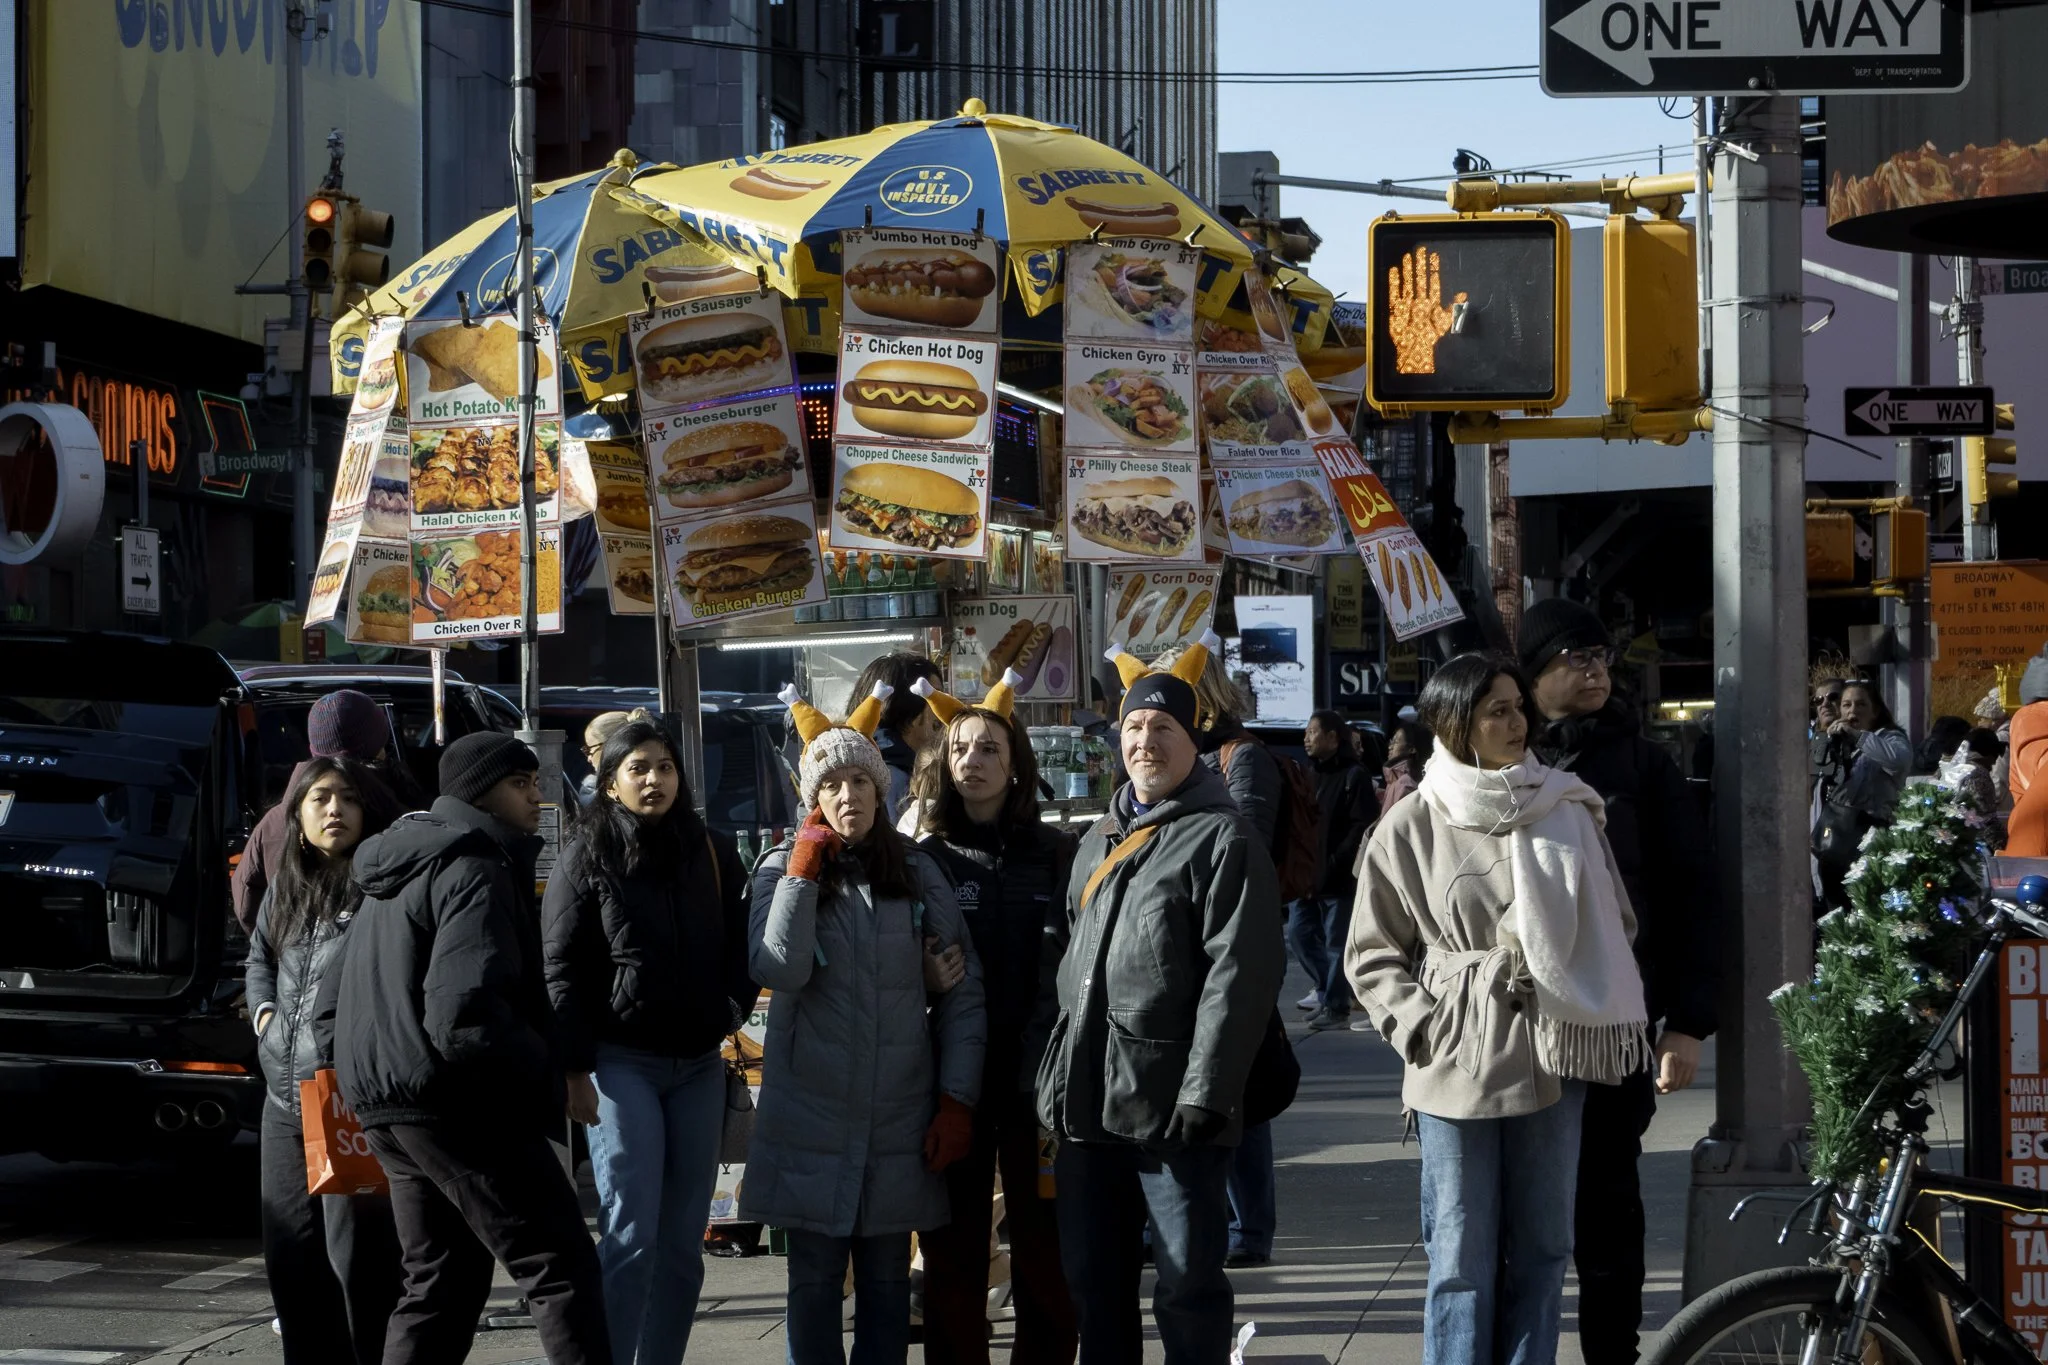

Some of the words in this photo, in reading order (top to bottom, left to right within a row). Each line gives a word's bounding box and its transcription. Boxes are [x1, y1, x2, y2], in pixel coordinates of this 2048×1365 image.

[1600, 0, 1721, 52] ONE
[1794, 0, 1924, 49] WAY
[1855, 68, 1871, 76] DEPT
[1875, 68, 1883, 76] OF
[1887, 67, 1942, 76] TRANSPORTATION
[1013, 168, 1147, 205] SABRETT
[886, 191, 959, 205] INSPECTED
[871, 230, 917, 243] Jumbo
[922, 233, 947, 245] Hot
[951, 235, 978, 250] Dog
[1109, 238, 1136, 249] amb
[1140, 240, 1171, 251] Gyro
[662, 304, 688, 320] Hot
[691, 294, 752, 315] Sausage
[845, 343, 863, 353] NY
[868, 338, 923, 357] Chicken
[927, 342, 953, 359] Hot
[956, 344, 984, 364] Dog
[1082, 346, 1133, 361] Chicken
[1137, 350, 1166, 365] Gyro
[1205, 354, 1236, 365] Chicken
[1238, 355, 1258, 365] Over
[1172, 363, 1190, 375] NY
[422, 401, 448, 418] Hot
[453, 399, 500, 416] Potato
[672, 402, 778, 428] Cheeseburger
[1869, 402, 1908, 421] ONE
[1936, 402, 1977, 421] WAY
[648, 431, 668, 443] NY
[590, 452, 610, 462] Hot
[613, 454, 644, 466] Potat
[846, 446, 889, 461] Chopped
[892, 449, 928, 463] Cheese
[931, 451, 979, 466] Sandwich
[1228, 448, 1257, 457] Falafel
[1259, 448, 1278, 456] Over
[1280, 447, 1300, 456] Rice
[219, 452, 286, 473] Broadway
[1088, 459, 1117, 473] Philly
[1120, 460, 1158, 472] Cheese
[1161, 461, 1192, 473] Steak
[1317, 446, 1372, 480] HALAL
[606, 471, 642, 483] Jumbo
[1069, 468, 1086, 478] NY
[1231, 469, 1263, 479] Chicken
[1265, 469, 1294, 479] Cheese
[1296, 467, 1320, 478] Steak
[967, 477, 986, 487] NY
[1346, 480, 1395, 529] حلال
[421, 514, 453, 526] Halal
[457, 510, 506, 524] Chicken
[510, 508, 548, 521] Kab
[135, 535, 147, 550] ALL
[623, 540, 651, 551] Philly
[664, 535, 682, 547] NY
[1387, 539, 1405, 551] Corn
[1405, 536, 1422, 549] Dog
[130, 553, 153, 568] TRAFFIC
[1152, 573, 1183, 585] Corn
[1187, 572, 1213, 586] Dog
[1954, 572, 2015, 584] BROADWAY
[1336, 584, 1353, 593] THE
[1974, 587, 1997, 598] BTW
[691, 598, 752, 619] Chicken
[755, 587, 807, 607] Burger
[953, 602, 985, 616] Corn
[989, 602, 1018, 618] Dog
[1332, 597, 1356, 609] LION
[1940, 602, 1965, 613] 47TH
[1967, 602, 1978, 613] ST
[1991, 602, 2017, 613] WEST
[2020, 601, 2045, 612] 48TH
[434, 621, 480, 635] Chicken
[483, 618, 511, 631] Over
[1330, 612, 1358, 627] KING
[1948, 626, 1981, 635] CLOSED
[1985, 625, 1996, 634] TO
[1999, 625, 2020, 634] THRU
[1136, 643, 1151, 653] Chili
[1339, 661, 1392, 696] SIX
[24, 863, 95, 877] PREMIER
[2010, 1078, 2041, 1096] MAN
[2010, 1117, 2047, 1132] BLAME
